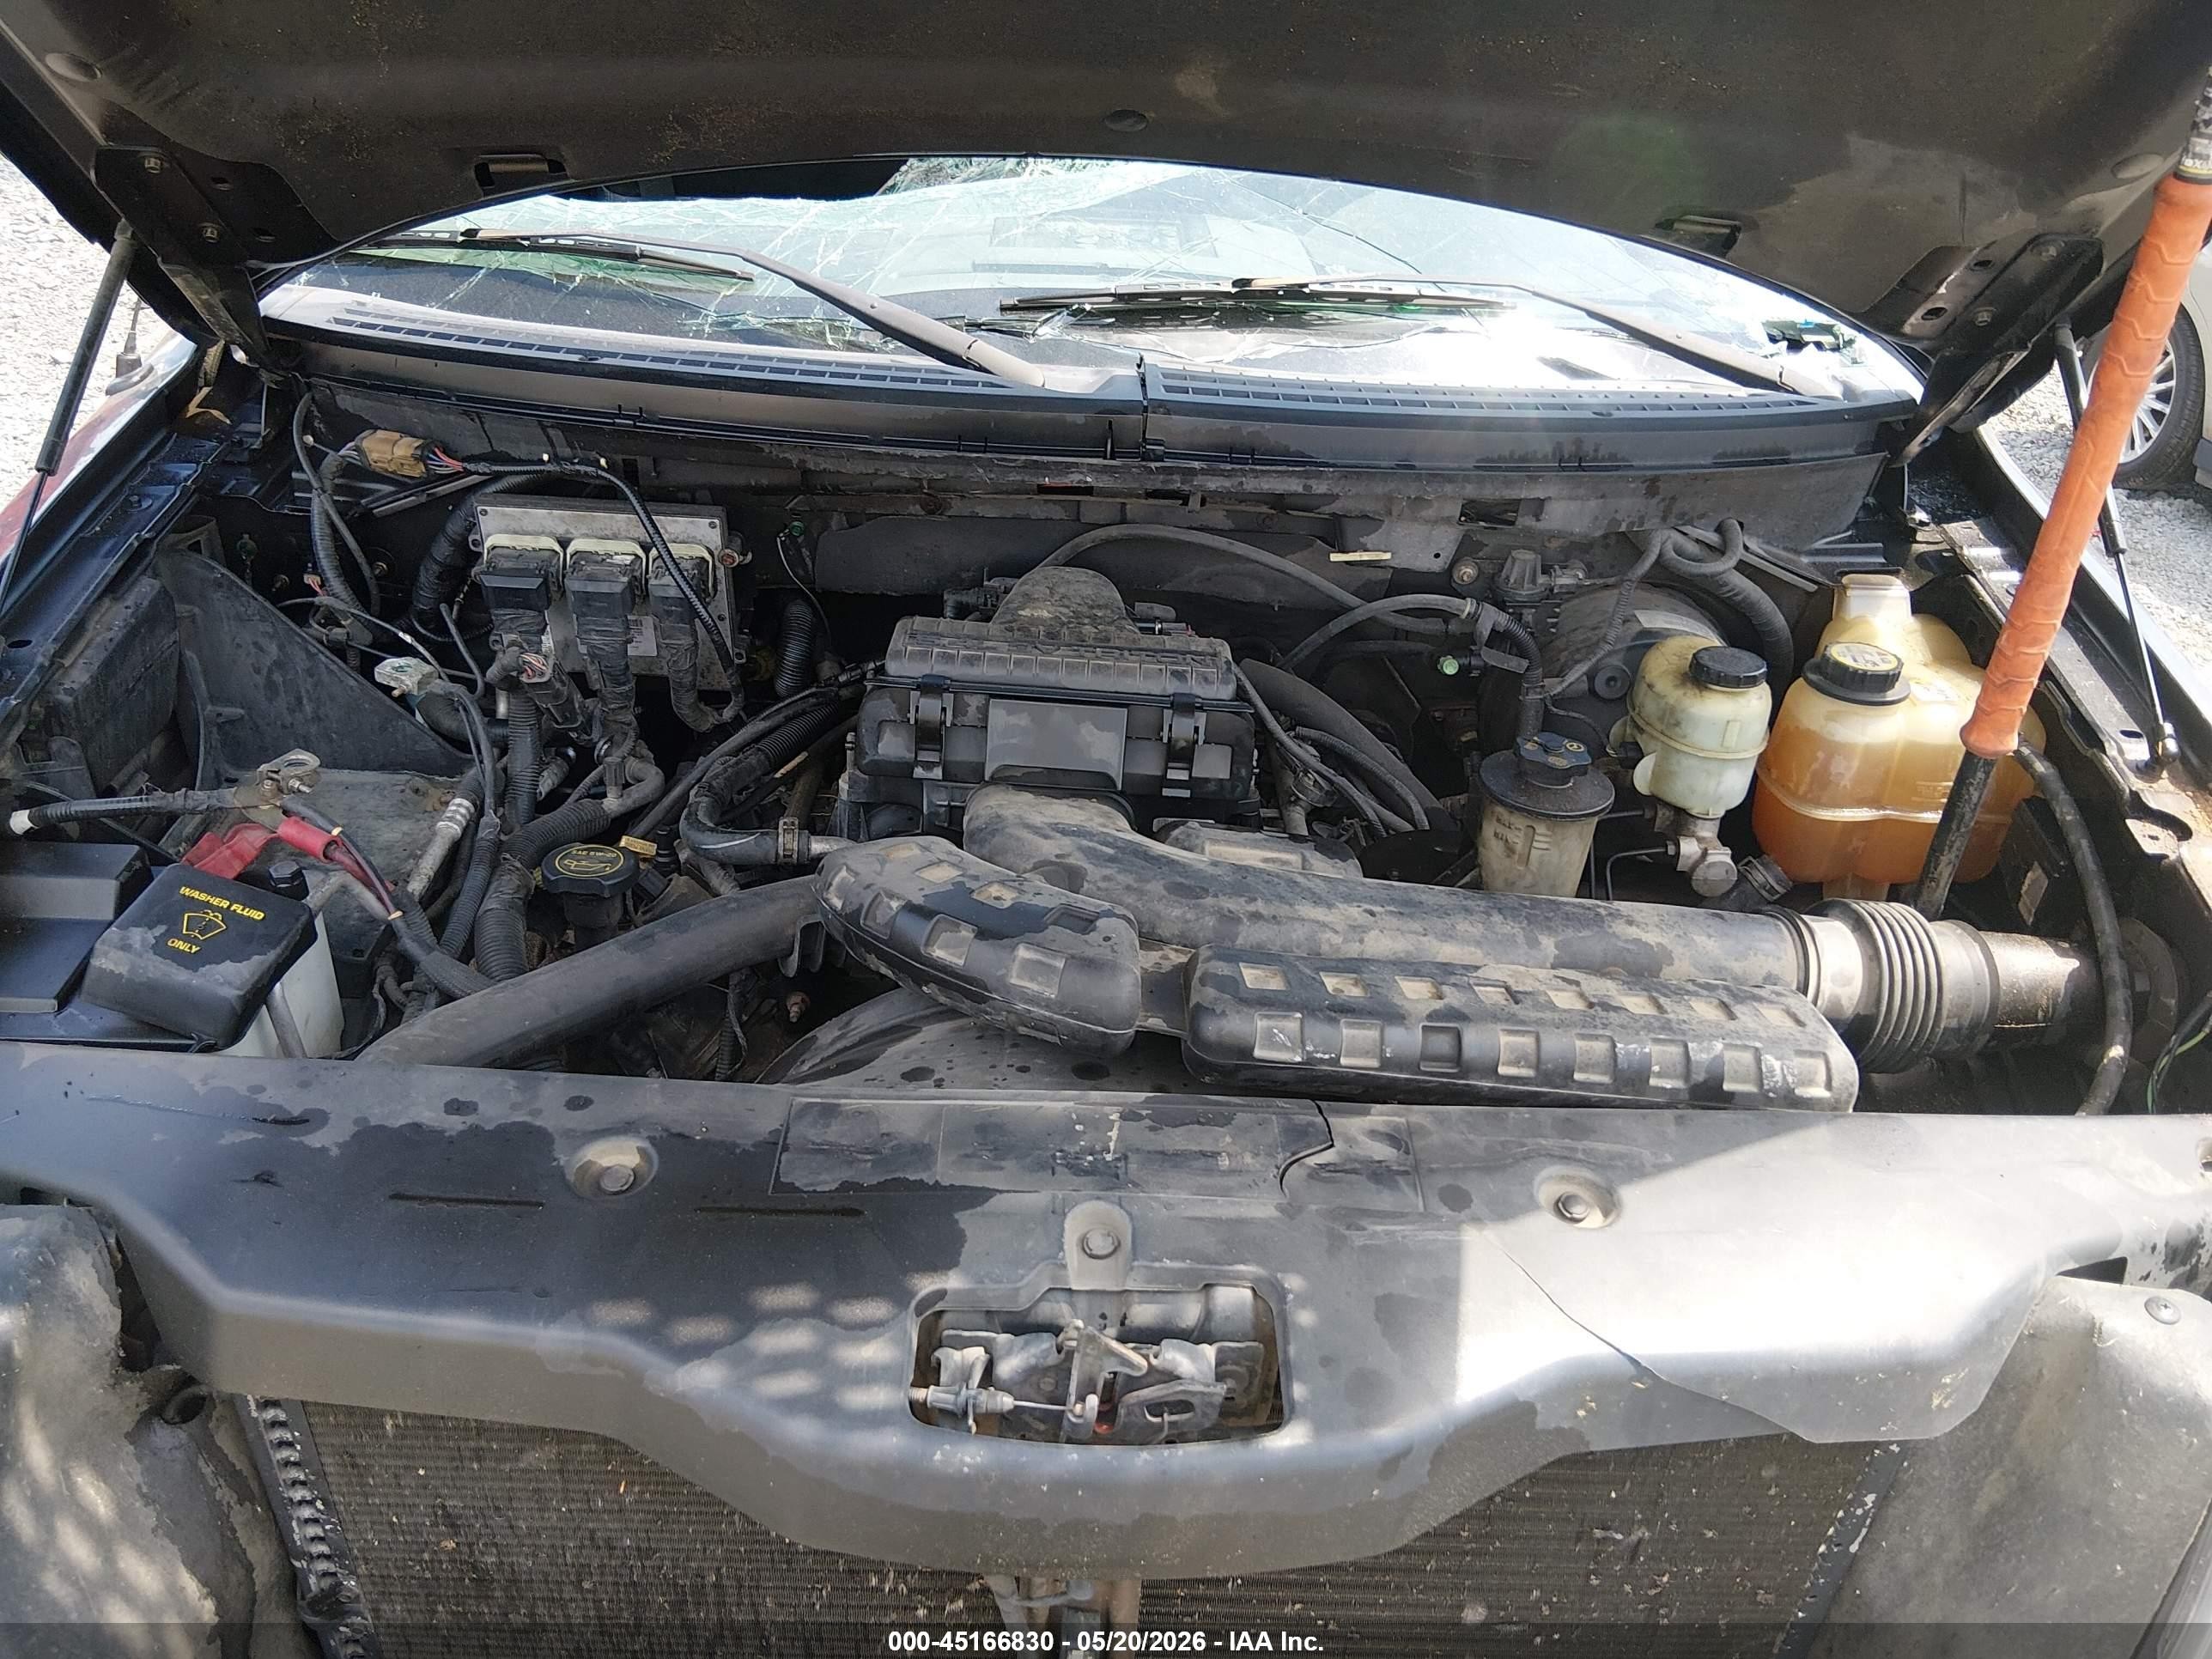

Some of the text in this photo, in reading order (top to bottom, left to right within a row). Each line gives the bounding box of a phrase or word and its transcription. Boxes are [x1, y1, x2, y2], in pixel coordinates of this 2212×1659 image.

[179, 886, 265, 921] WASHER FLUID
[167, 938, 202, 954] ONLY
